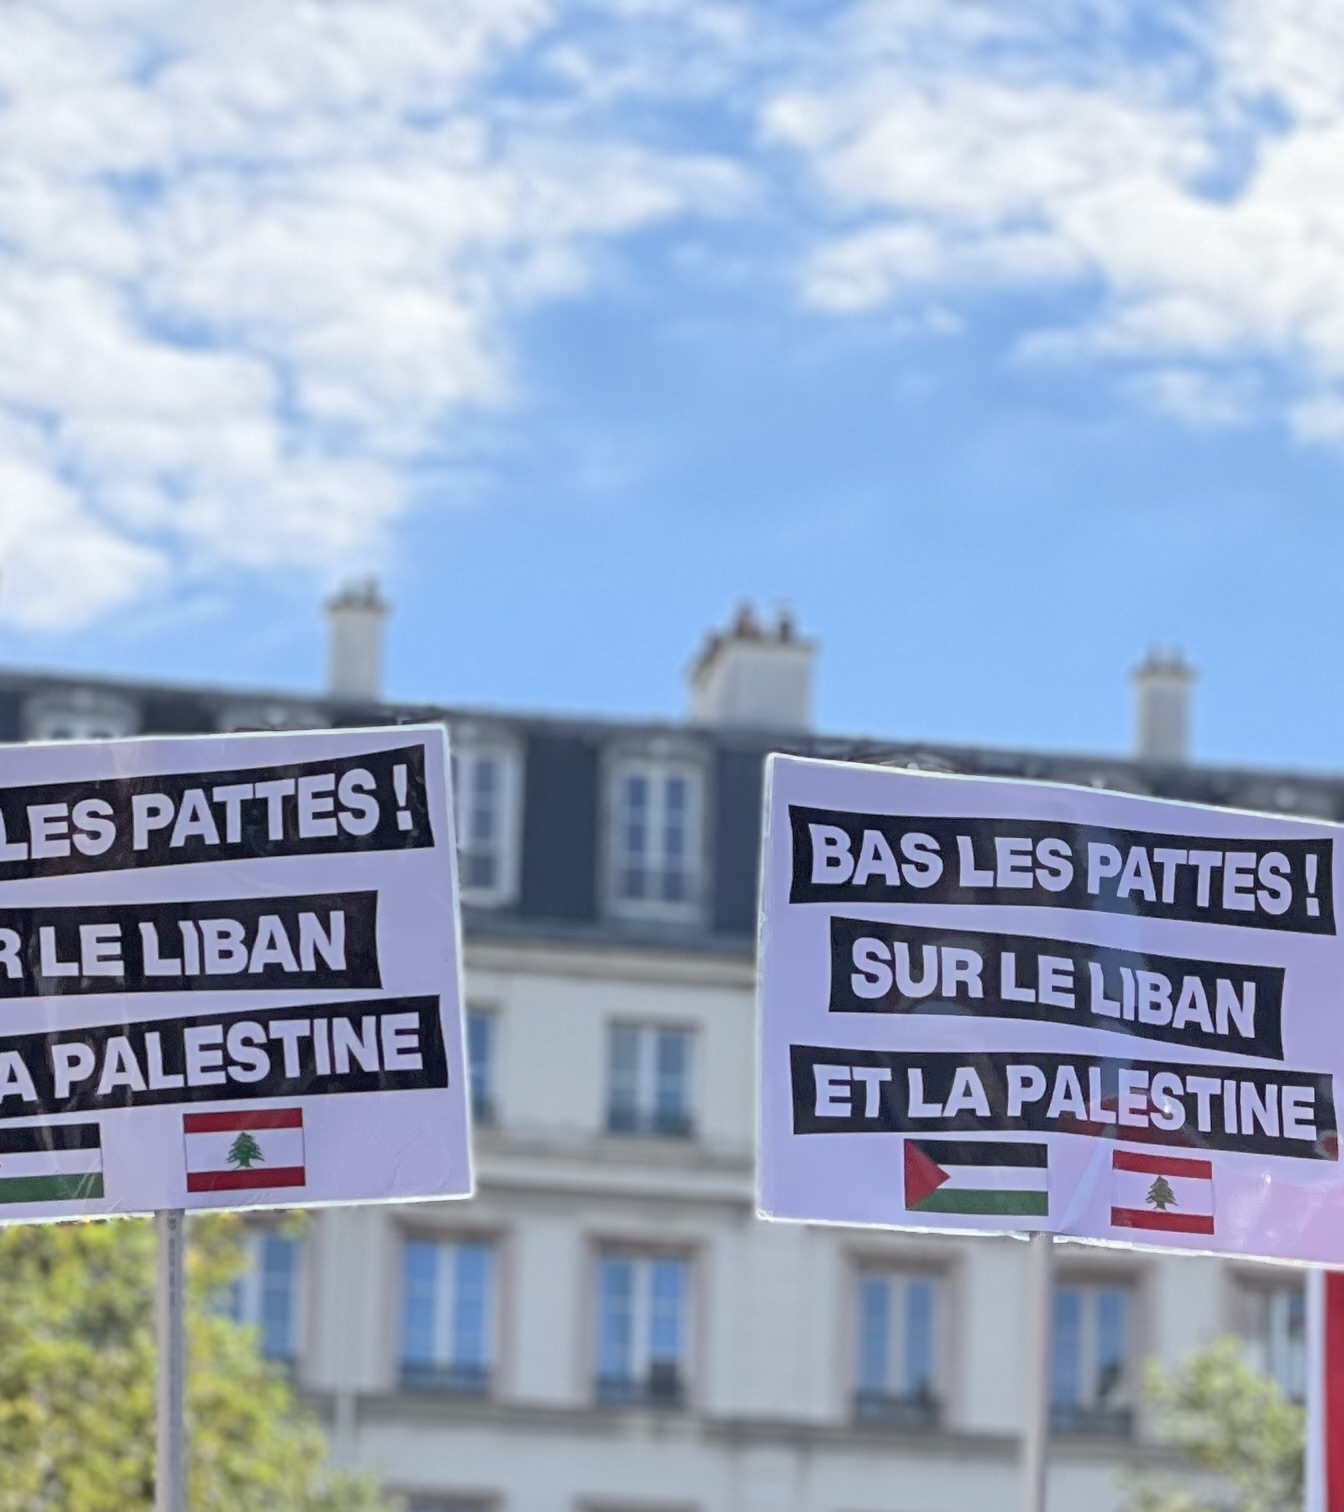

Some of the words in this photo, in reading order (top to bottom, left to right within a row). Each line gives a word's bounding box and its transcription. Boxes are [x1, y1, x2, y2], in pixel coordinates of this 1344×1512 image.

[131, 768, 380, 851] PATTES
[807, 823, 944, 889] BAS
[955, 835, 1074, 892] LES
[1087, 841, 1293, 915] PATTES
[39, 923, 125, 978] LE
[138, 910, 347, 977] LIBAN
[850, 937, 984, 999] SUR
[1000, 951, 1076, 1009] LE
[1087, 961, 1256, 1039] LIBAN
[50, 1011, 424, 1099] PALESTINE
[812, 1063, 893, 1118] ET
[907, 1066, 992, 1118] LA
[1005, 1064, 1318, 1142] PALESTINE
